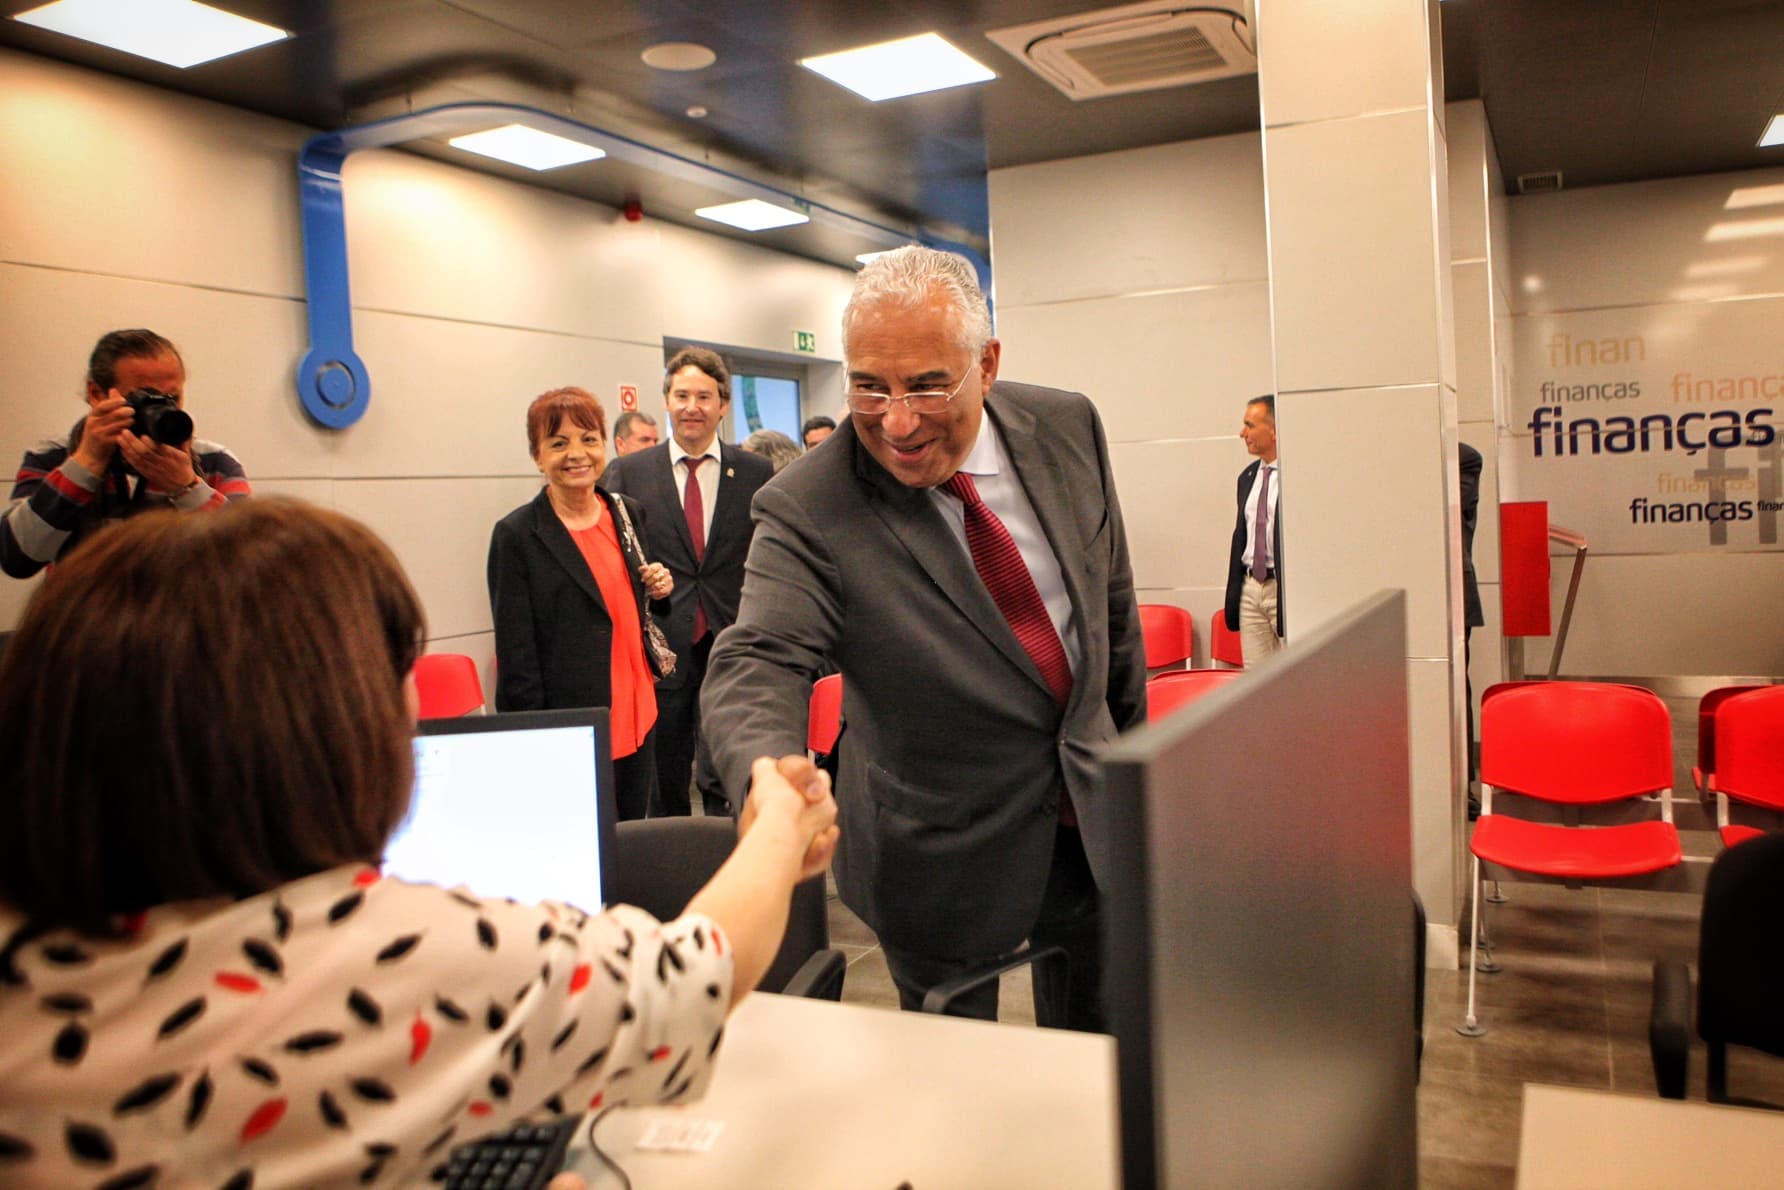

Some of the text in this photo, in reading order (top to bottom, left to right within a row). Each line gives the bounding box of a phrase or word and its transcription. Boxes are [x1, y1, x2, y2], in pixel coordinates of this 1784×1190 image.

[1540, 381, 1640, 403] finanças
[1672, 373, 1784, 403] finanç
[1527, 406, 1776, 457] finanças
[1629, 497, 1753, 526] finanças
